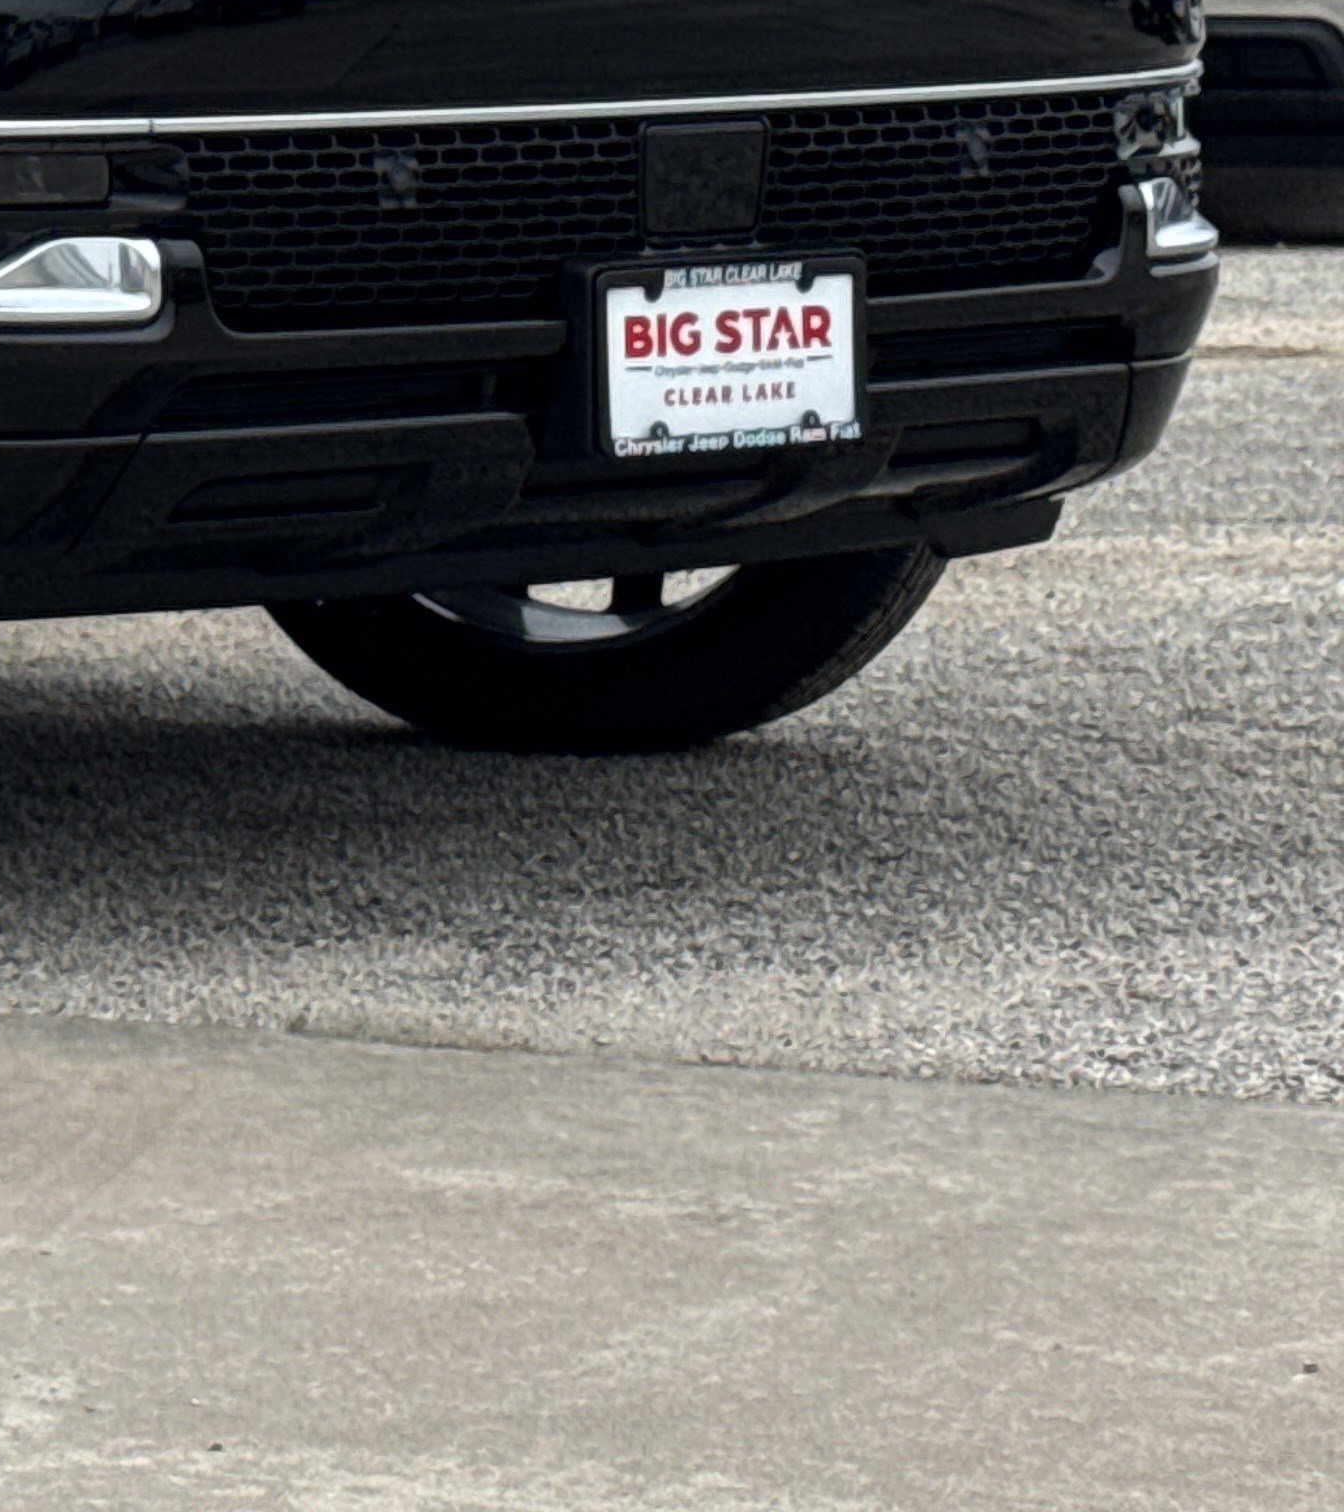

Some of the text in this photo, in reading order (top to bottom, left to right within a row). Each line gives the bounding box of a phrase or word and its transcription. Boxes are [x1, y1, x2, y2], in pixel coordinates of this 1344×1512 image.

[624, 305, 832, 359] BIG STAR
[663, 381, 796, 407] CLEAR LAKE
[688, 434, 729, 453] Jeep
